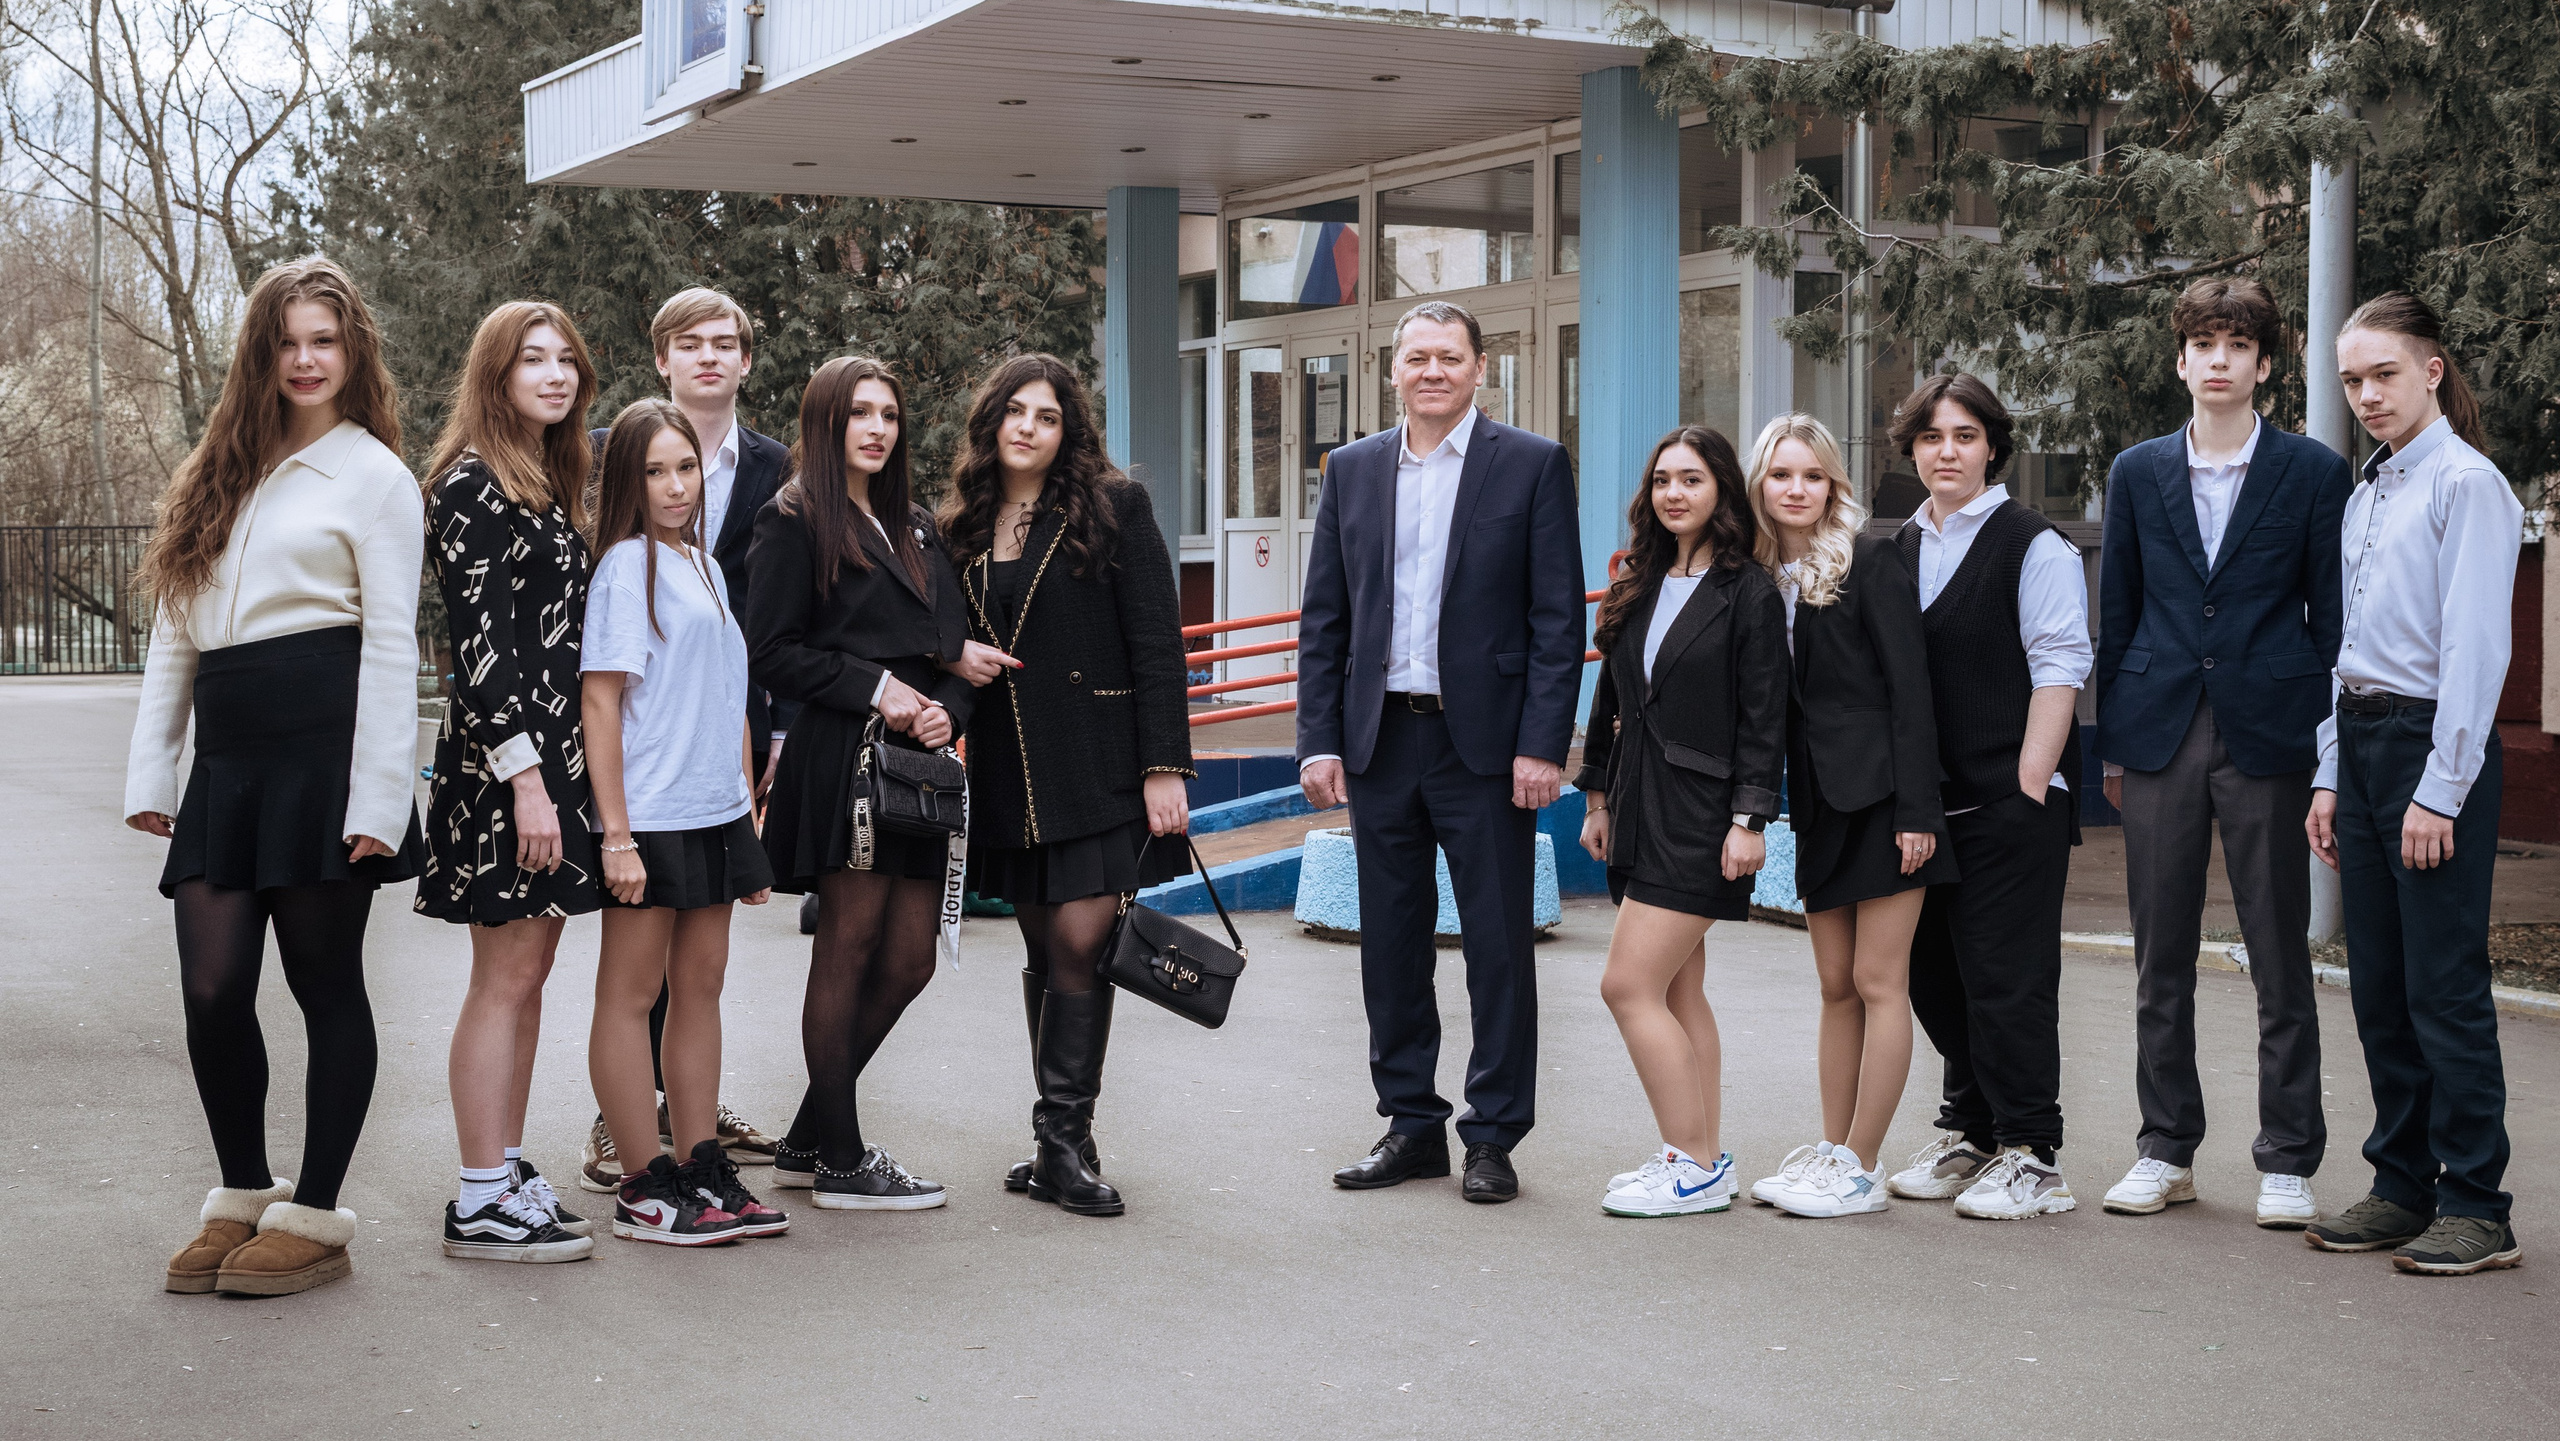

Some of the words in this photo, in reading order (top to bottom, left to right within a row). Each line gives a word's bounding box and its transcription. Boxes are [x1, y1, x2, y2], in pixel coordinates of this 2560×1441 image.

[922, 783, 935, 793] Dior
[859, 825, 870, 847] DIOR
[942, 852, 964, 925] J'ADIOR
